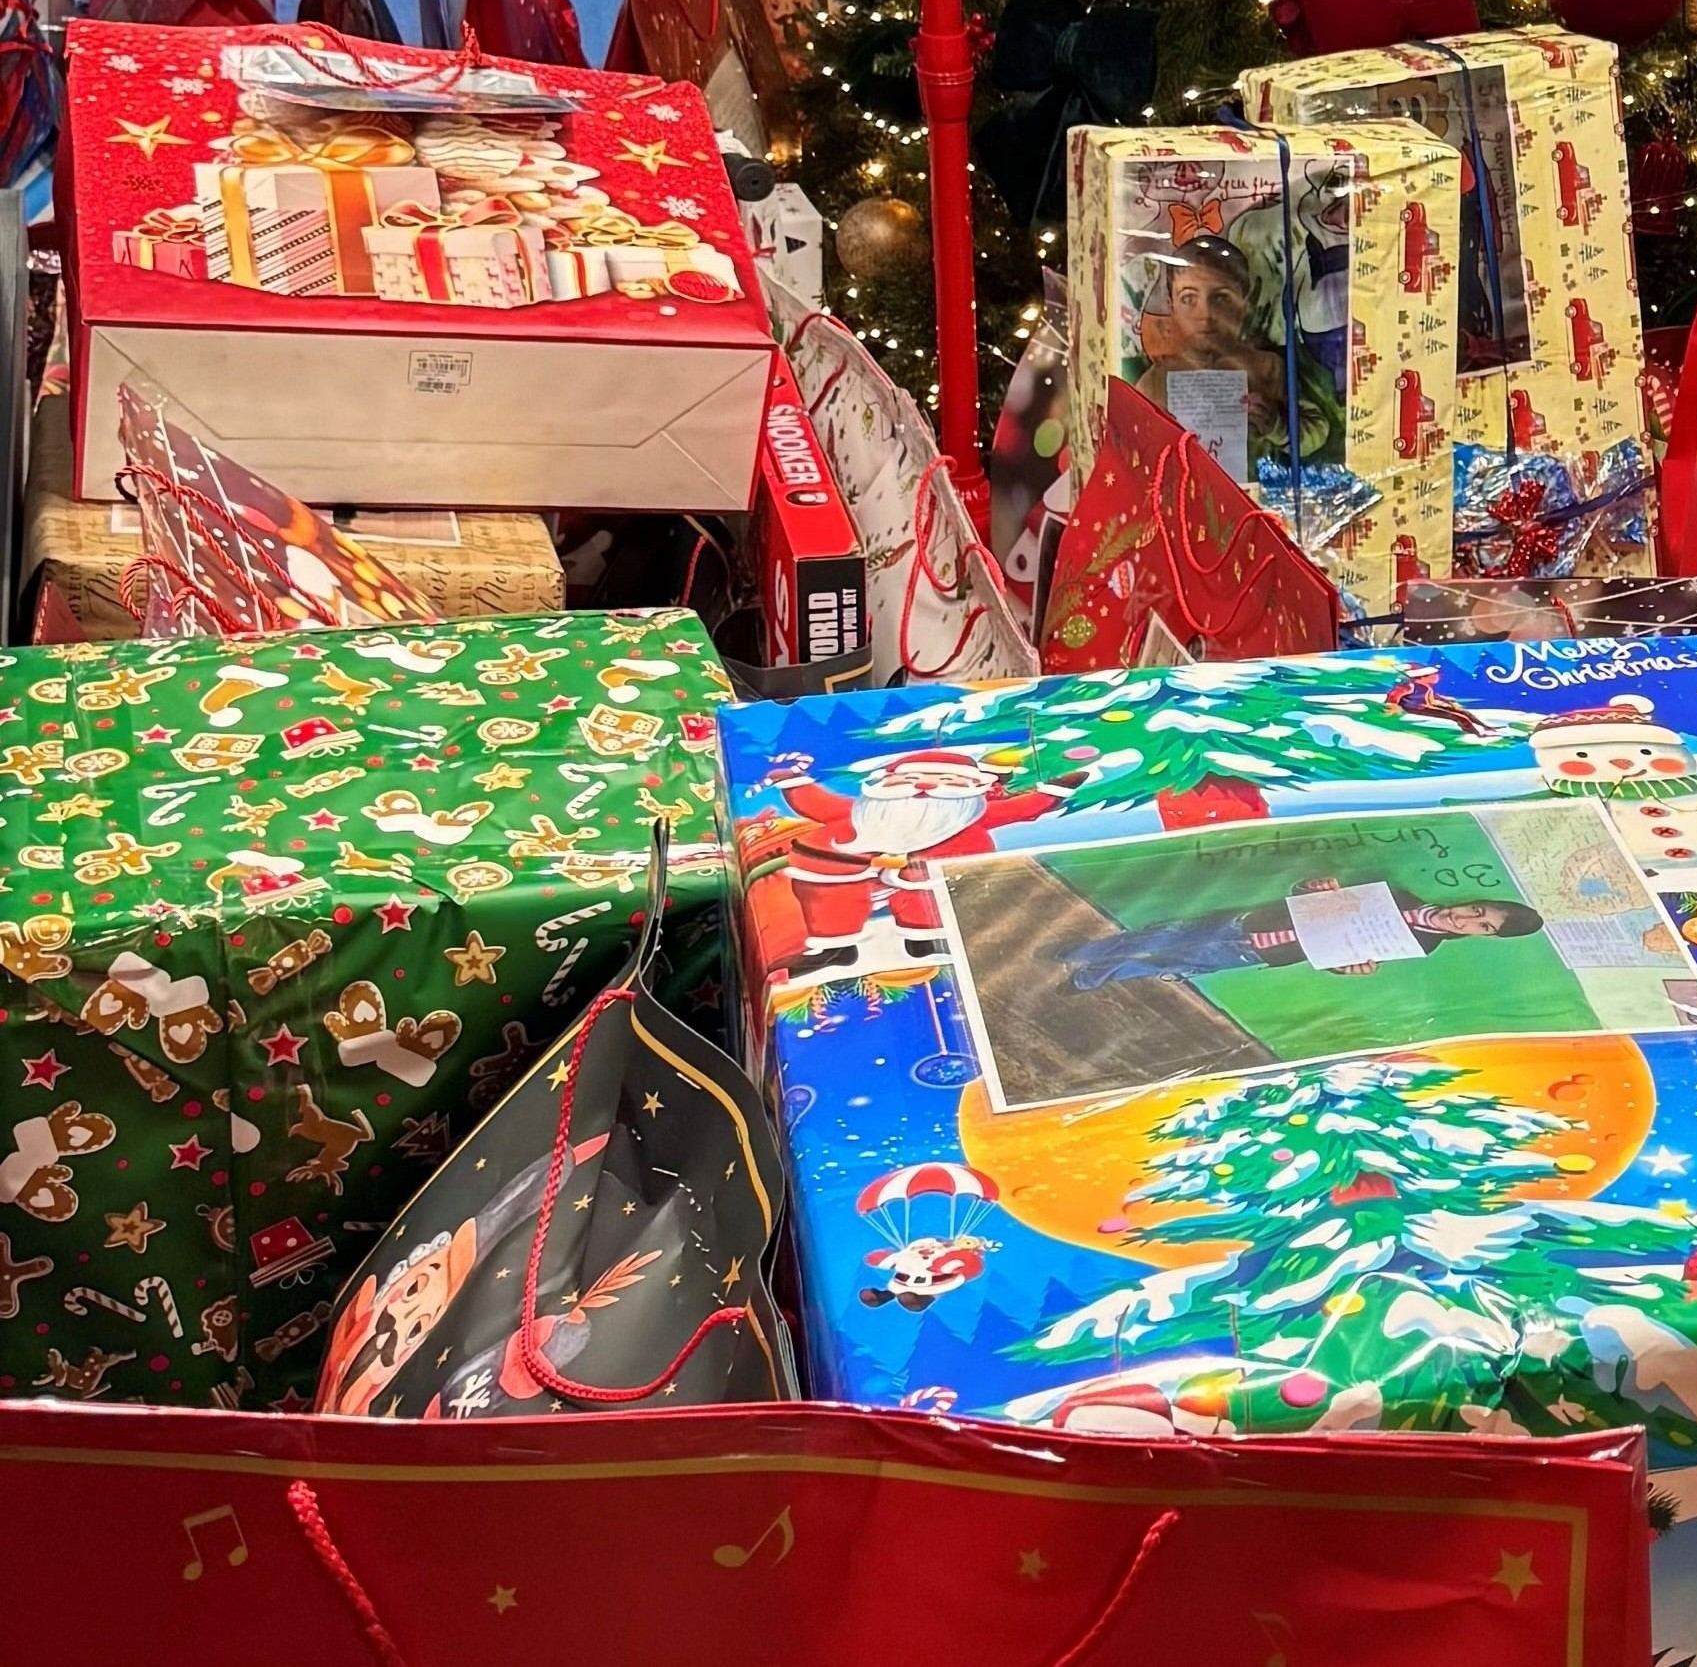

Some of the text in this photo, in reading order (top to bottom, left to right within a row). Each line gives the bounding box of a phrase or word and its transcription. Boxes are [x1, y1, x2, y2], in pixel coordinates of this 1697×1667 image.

[766, 404, 822, 485] SNOOKER
[842, 588, 858, 605] SET
[1485, 637, 1652, 684] Merry
